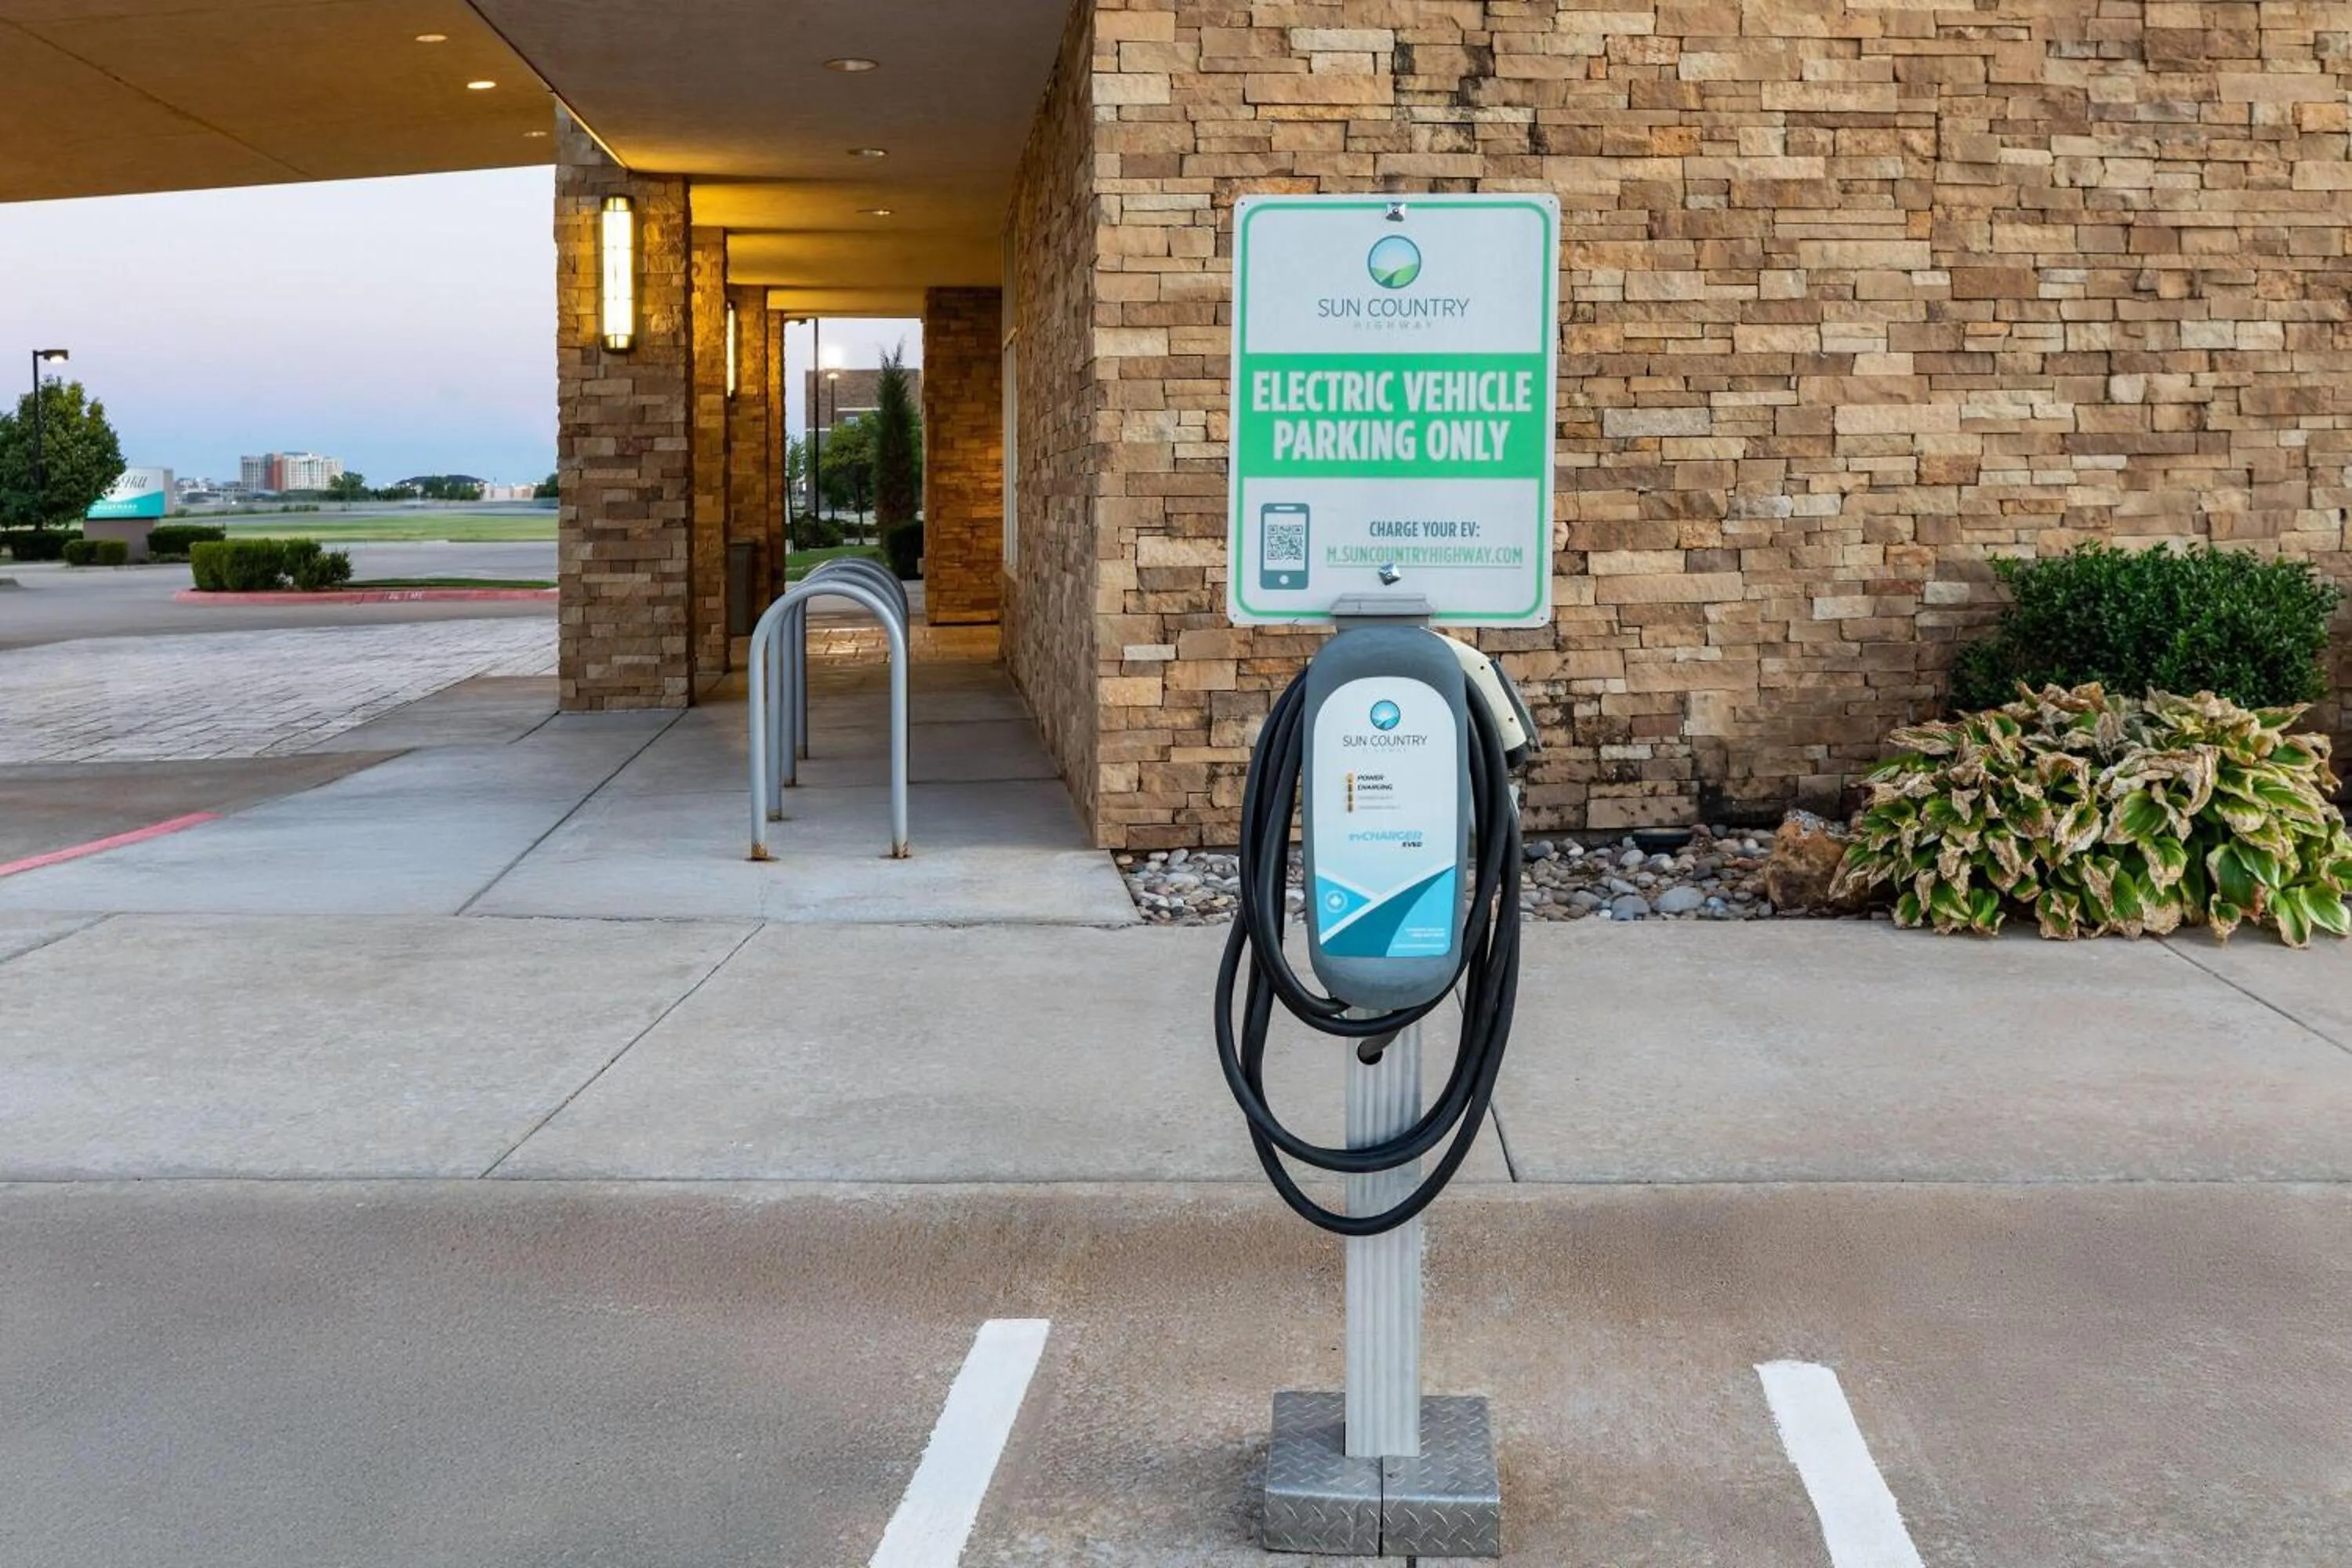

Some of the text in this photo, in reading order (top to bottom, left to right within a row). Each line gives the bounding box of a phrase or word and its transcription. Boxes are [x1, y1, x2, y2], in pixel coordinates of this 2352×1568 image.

[1318, 298, 1470, 317] SUN COUNTRY
[1252, 371, 1533, 412] ELECTRIC VEHICLE
[1272, 420, 1511, 461] PARKING ONLY
[1370, 521, 1481, 538] CHARGE YOUR EV:
[1342, 735, 1428, 746] SUN COUNTRY
